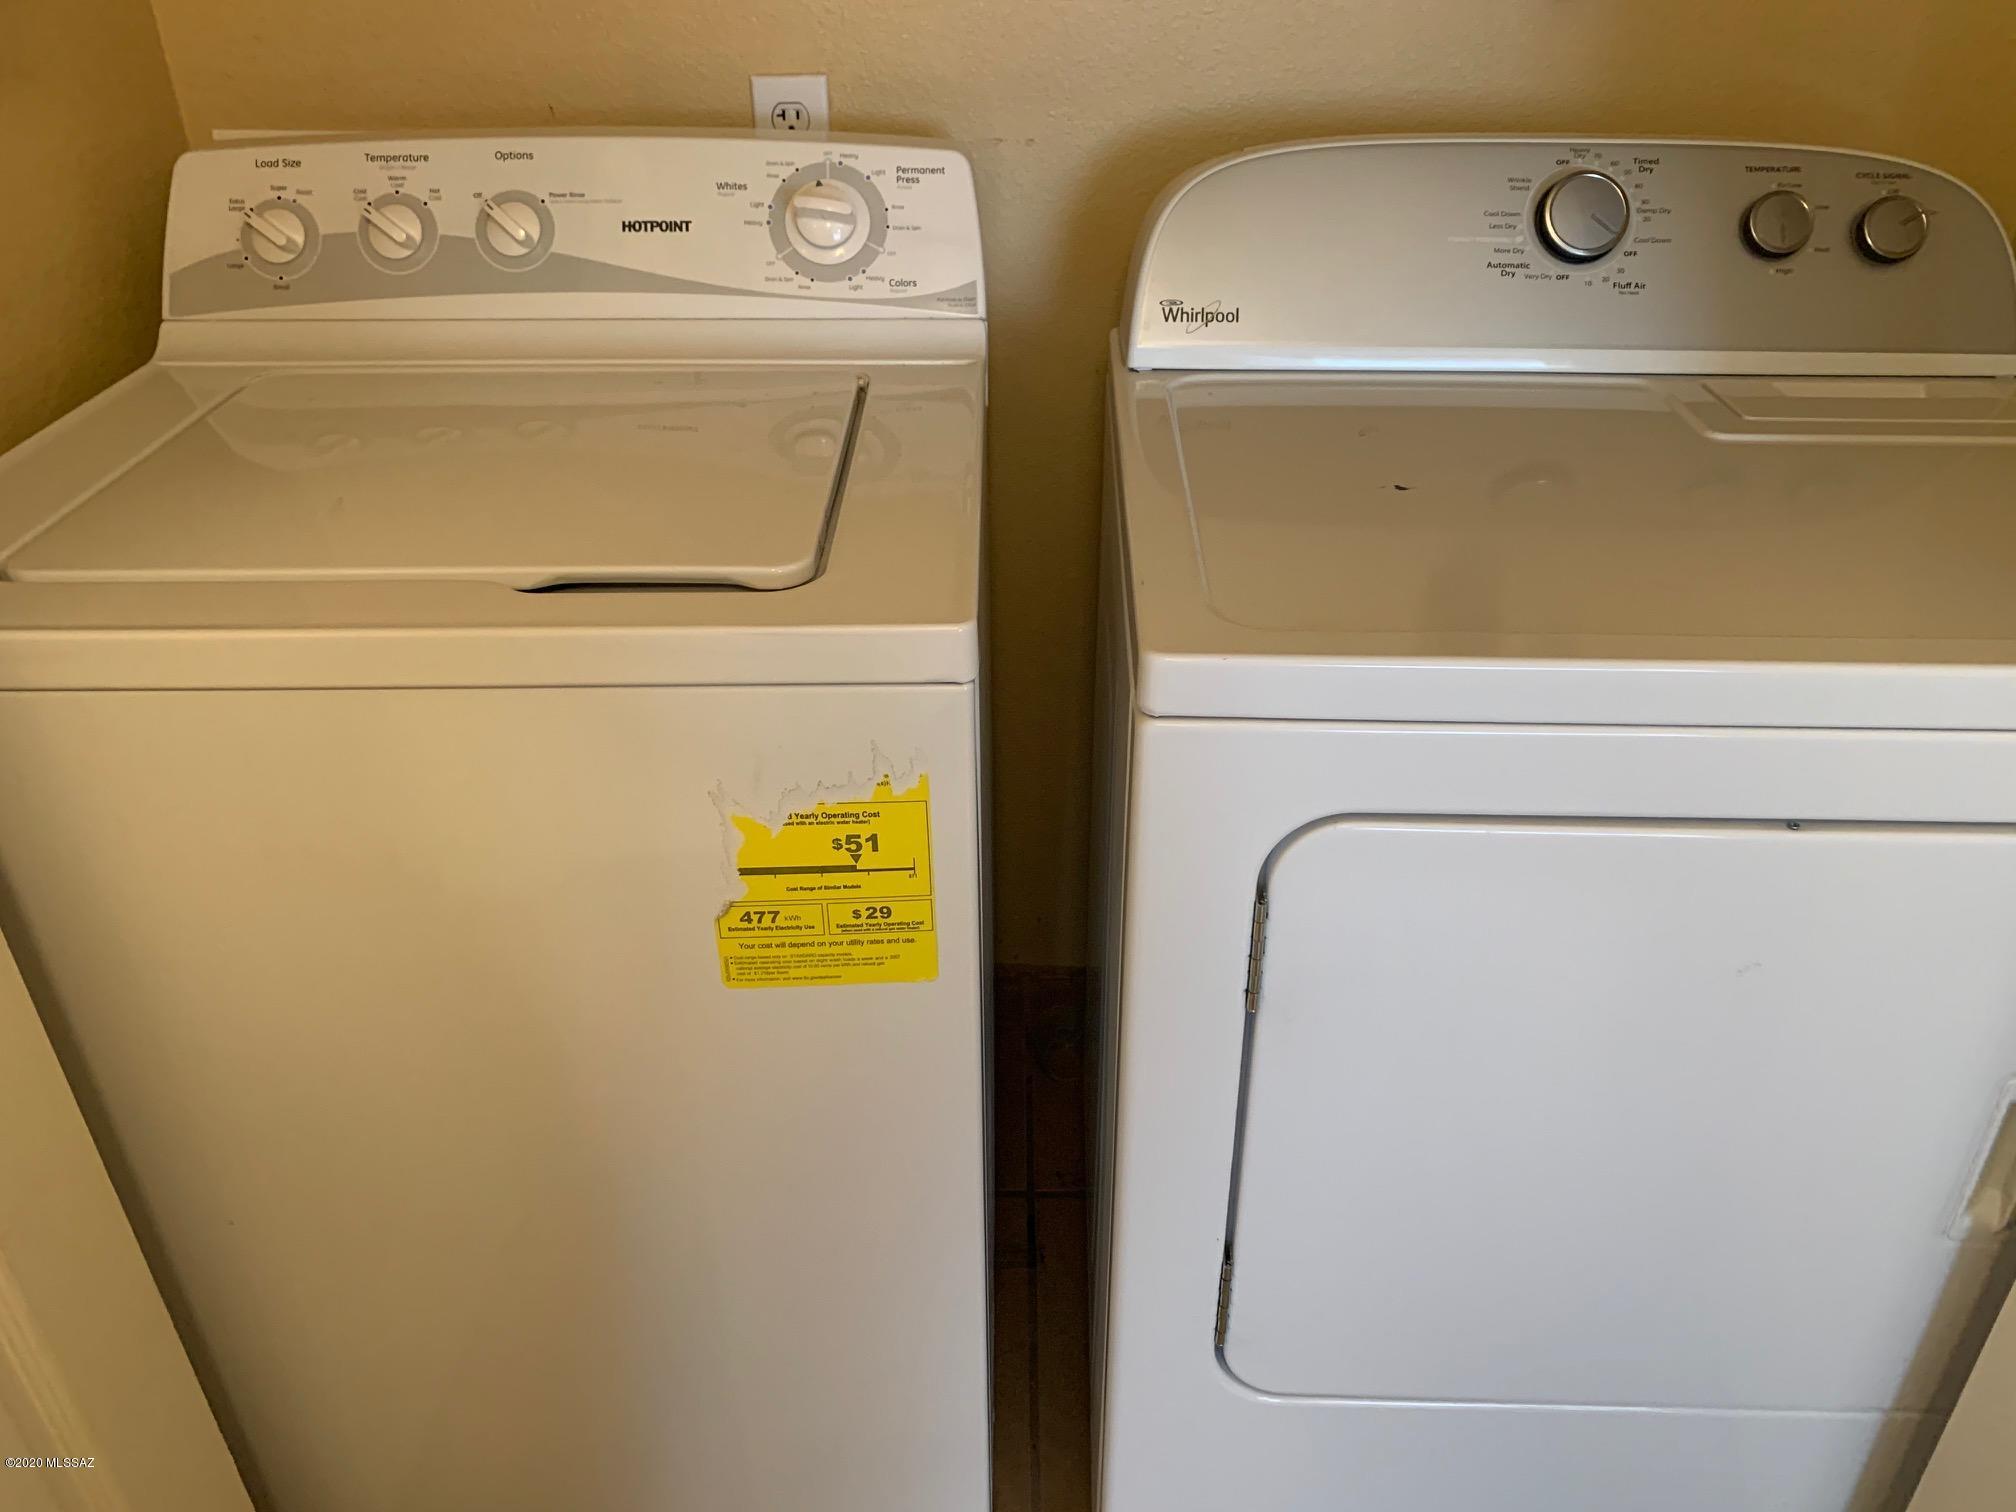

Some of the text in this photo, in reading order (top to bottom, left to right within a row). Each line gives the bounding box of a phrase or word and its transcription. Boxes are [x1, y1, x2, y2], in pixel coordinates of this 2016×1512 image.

[364, 152, 430, 164] Temperature
[494, 150, 534, 162] Options
[1633, 157, 1660, 165] Timed
[255, 158, 302, 168] Load Size
[896, 165, 946, 176] Permanent
[1638, 165, 1654, 174] Dry
[1745, 165, 1802, 173] TEMPERATURE
[896, 175, 921, 185] Press
[715, 181, 748, 191] Whites
[621, 220, 692, 232] HOTPOINT
[1512, 247, 1525, 255] Dry
[1486, 261, 1531, 269] Automatic
[1500, 269, 1516, 278] Dry
[888, 278, 918, 288] Colors
[1612, 281, 1647, 289] Fluff Air
[1161, 304, 1240, 328] Whirlpool
[794, 811, 819, 821] Yearly
[820, 810, 860, 820] Operating
[861, 810, 881, 818] Cost
[831, 832, 880, 854] $51
[739, 910, 780, 925] 477
[883, 920, 911, 928] Operating
[757, 941, 773, 949] cost
[774, 940, 787, 948] will
[787, 939, 816, 949] depend
[827, 939, 844, 948] your
[845, 938, 865, 946] utility
[886, 936, 901, 944] and
